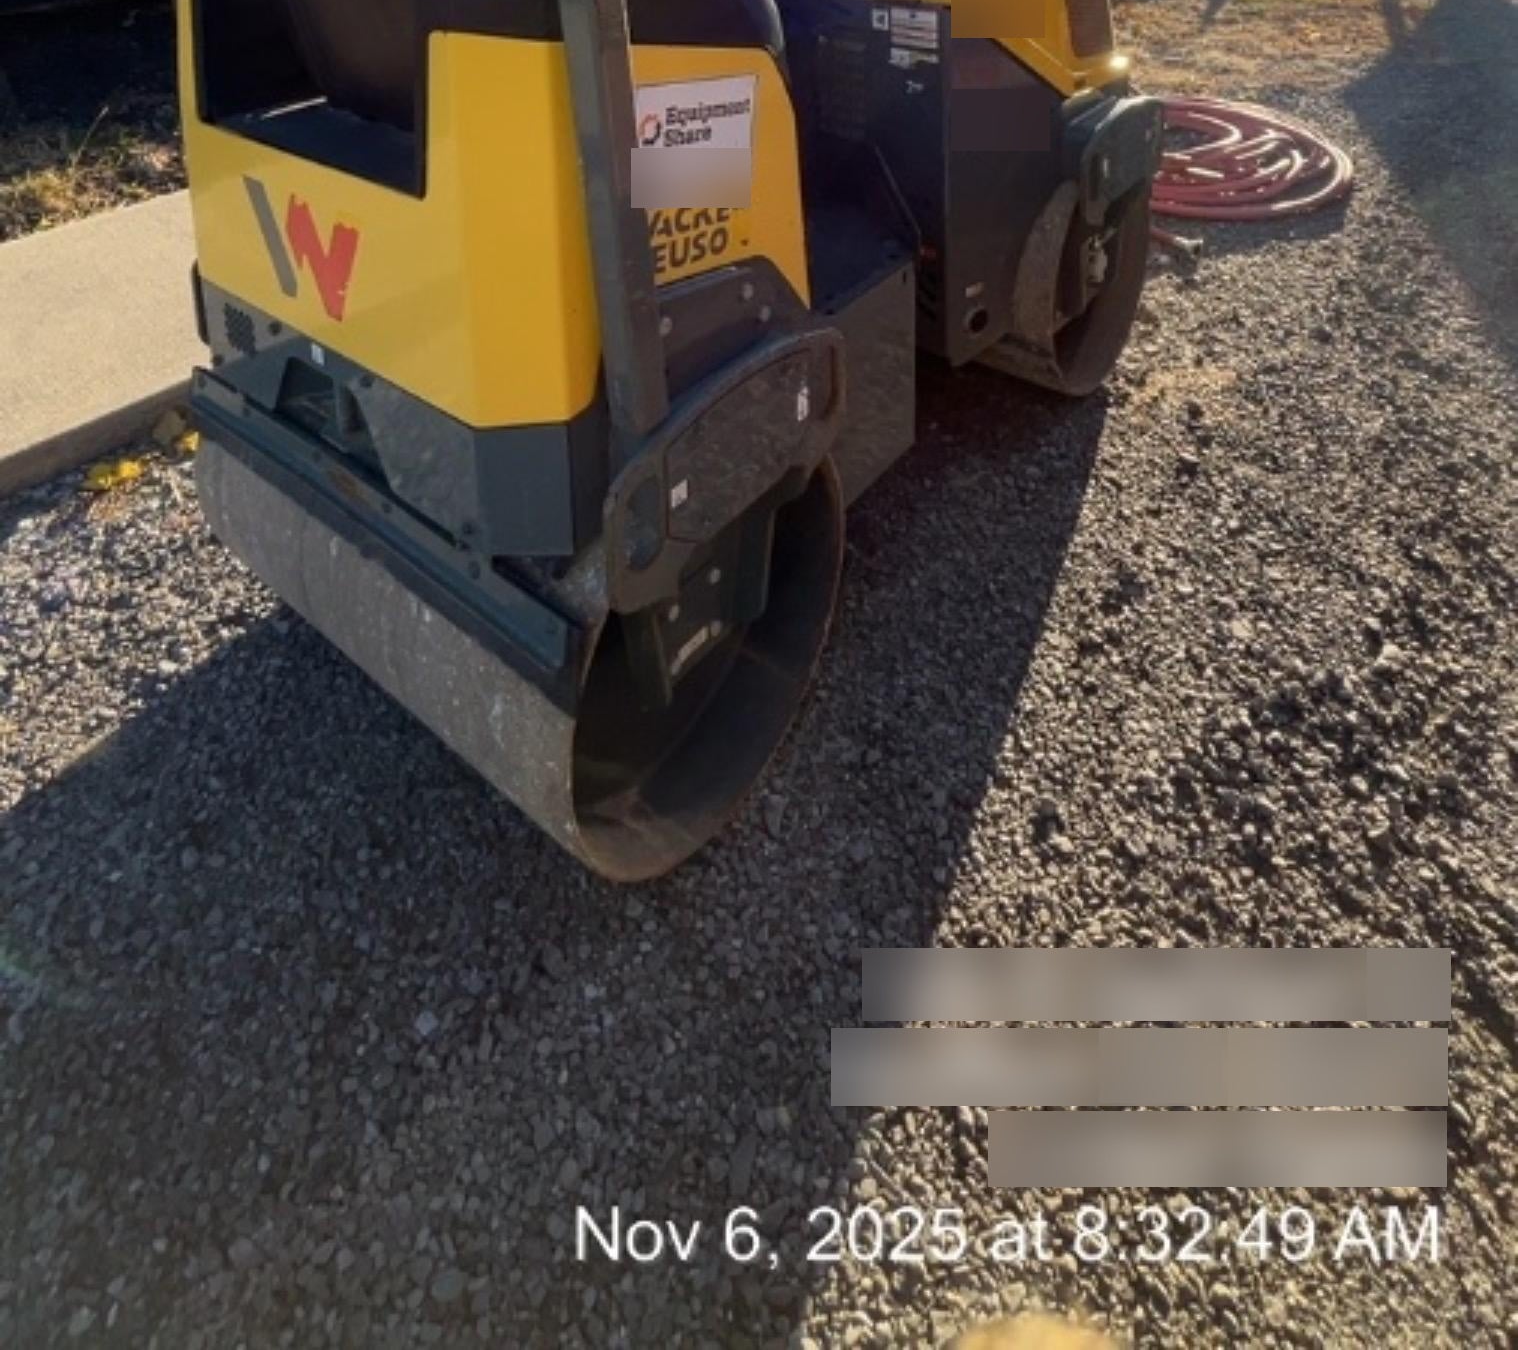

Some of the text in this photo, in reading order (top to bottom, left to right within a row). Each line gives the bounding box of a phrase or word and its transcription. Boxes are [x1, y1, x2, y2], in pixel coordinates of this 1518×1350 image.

[665, 98, 750, 126] Equipment
[663, 126, 712, 147] Share
[651, 227, 729, 274] EUSO
